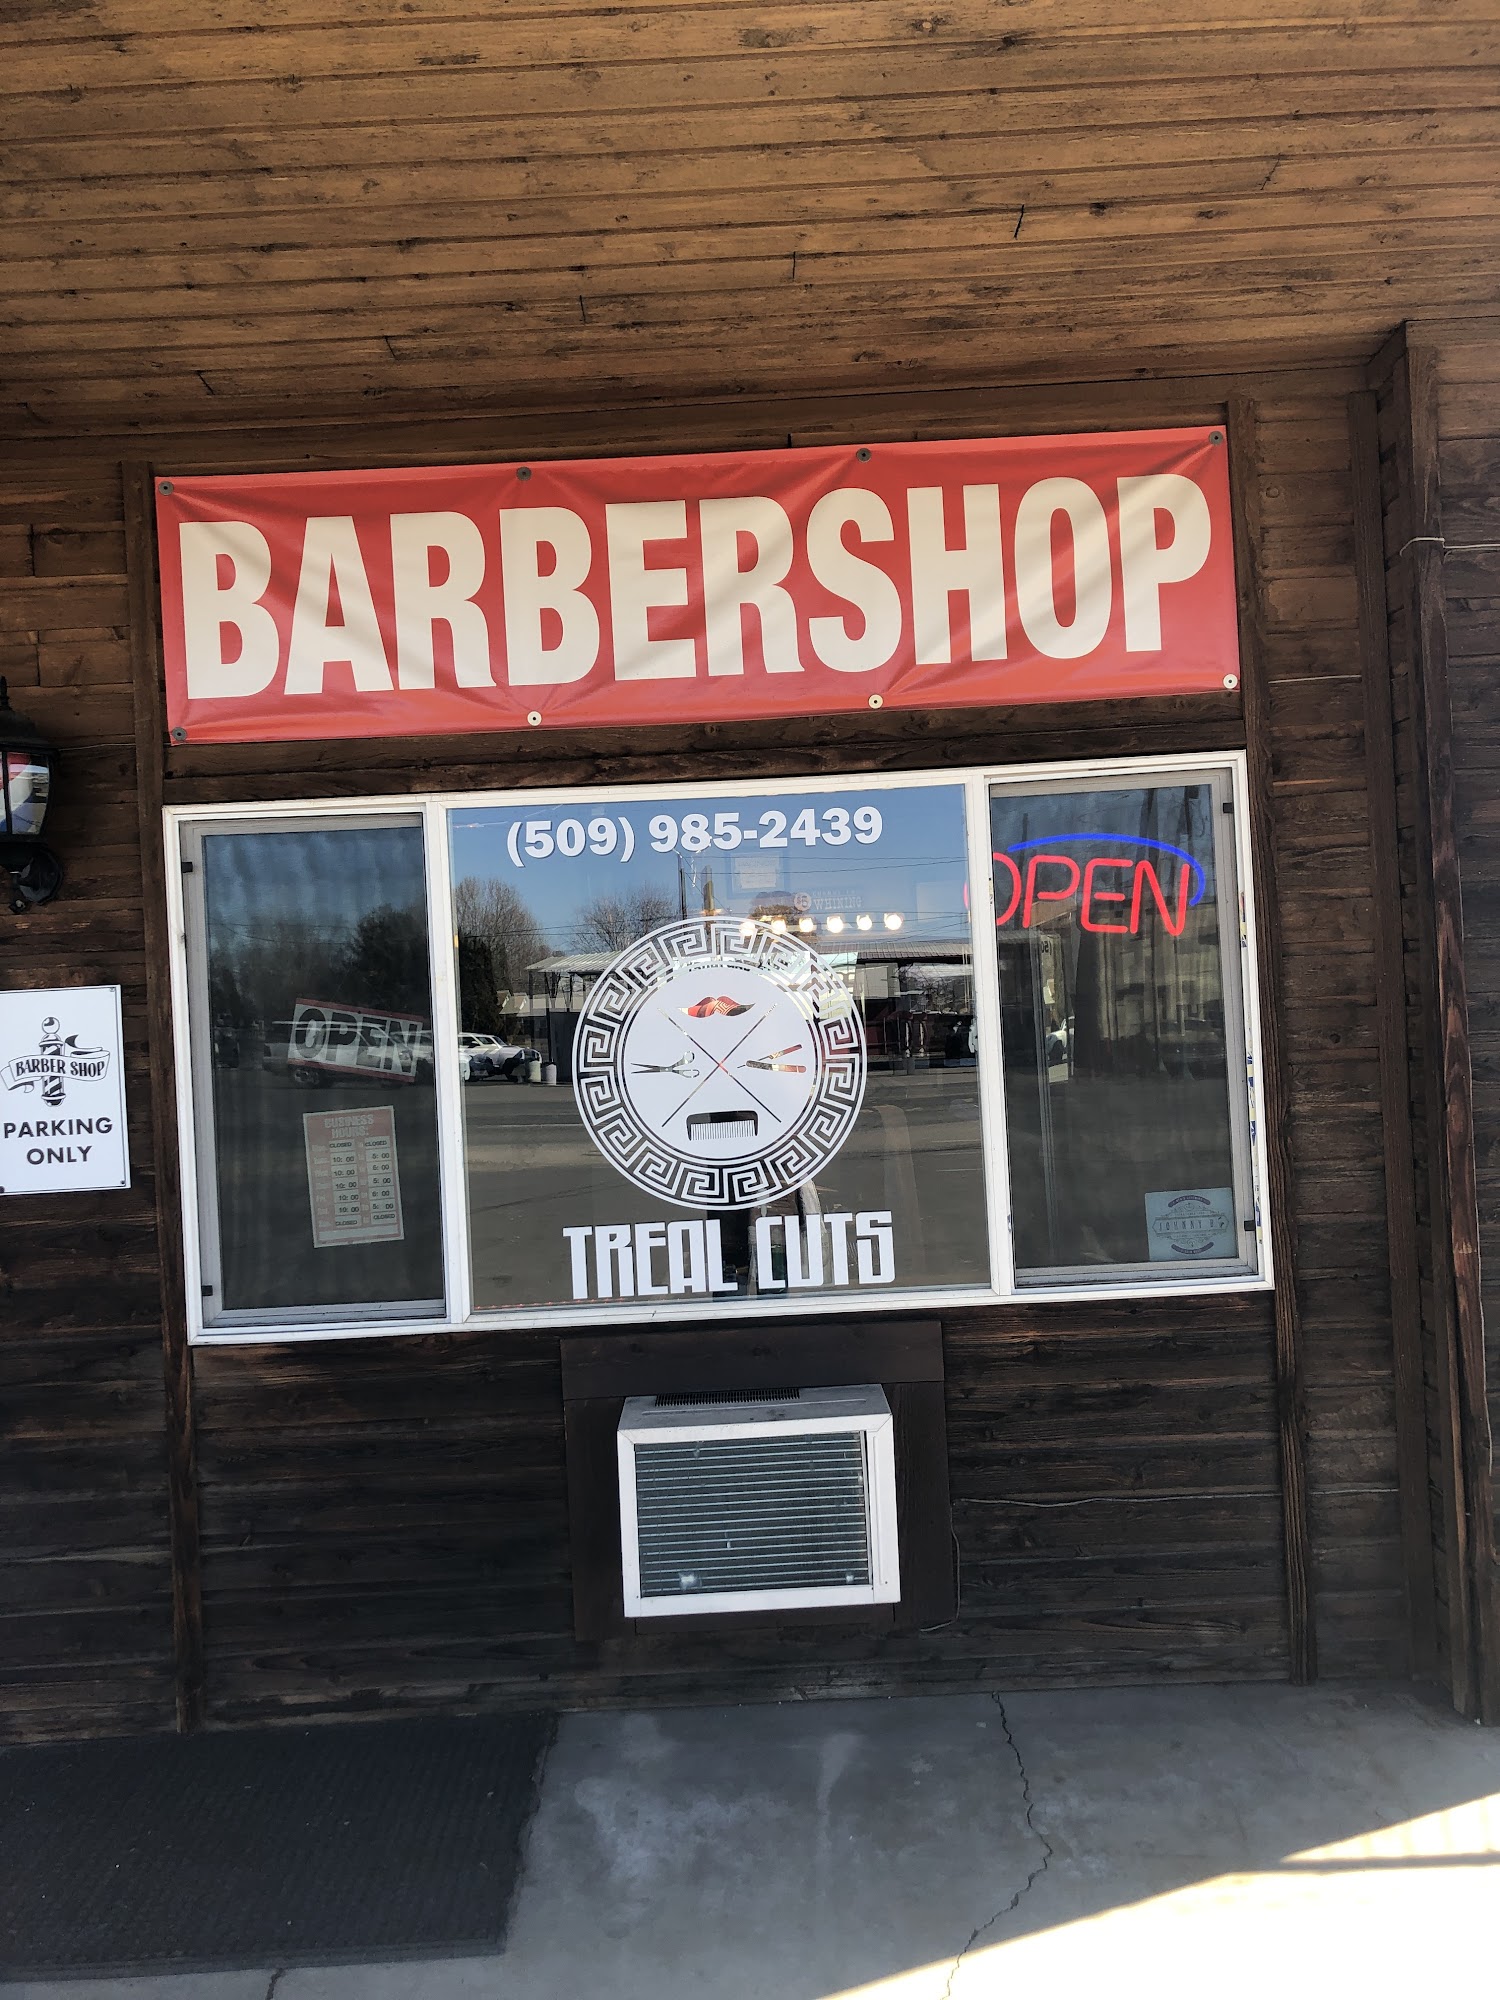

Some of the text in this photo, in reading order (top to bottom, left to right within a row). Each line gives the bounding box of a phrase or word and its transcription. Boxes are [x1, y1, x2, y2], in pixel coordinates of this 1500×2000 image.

[179, 473, 1212, 699] BARBERSHOP
[506, 806, 883, 868] (509) 985-2439
[295, 1008, 418, 1074] OPEN
[15, 1057, 106, 1078] BARBER SHOP
[3, 1116, 114, 1139] PARKING
[324, 1114, 374, 1128] BUSINESS
[26, 1145, 93, 1165] ONLY
[1159, 1219, 1202, 1231] JOHNNY
[563, 1210, 896, 1300] TREAL CUTS
